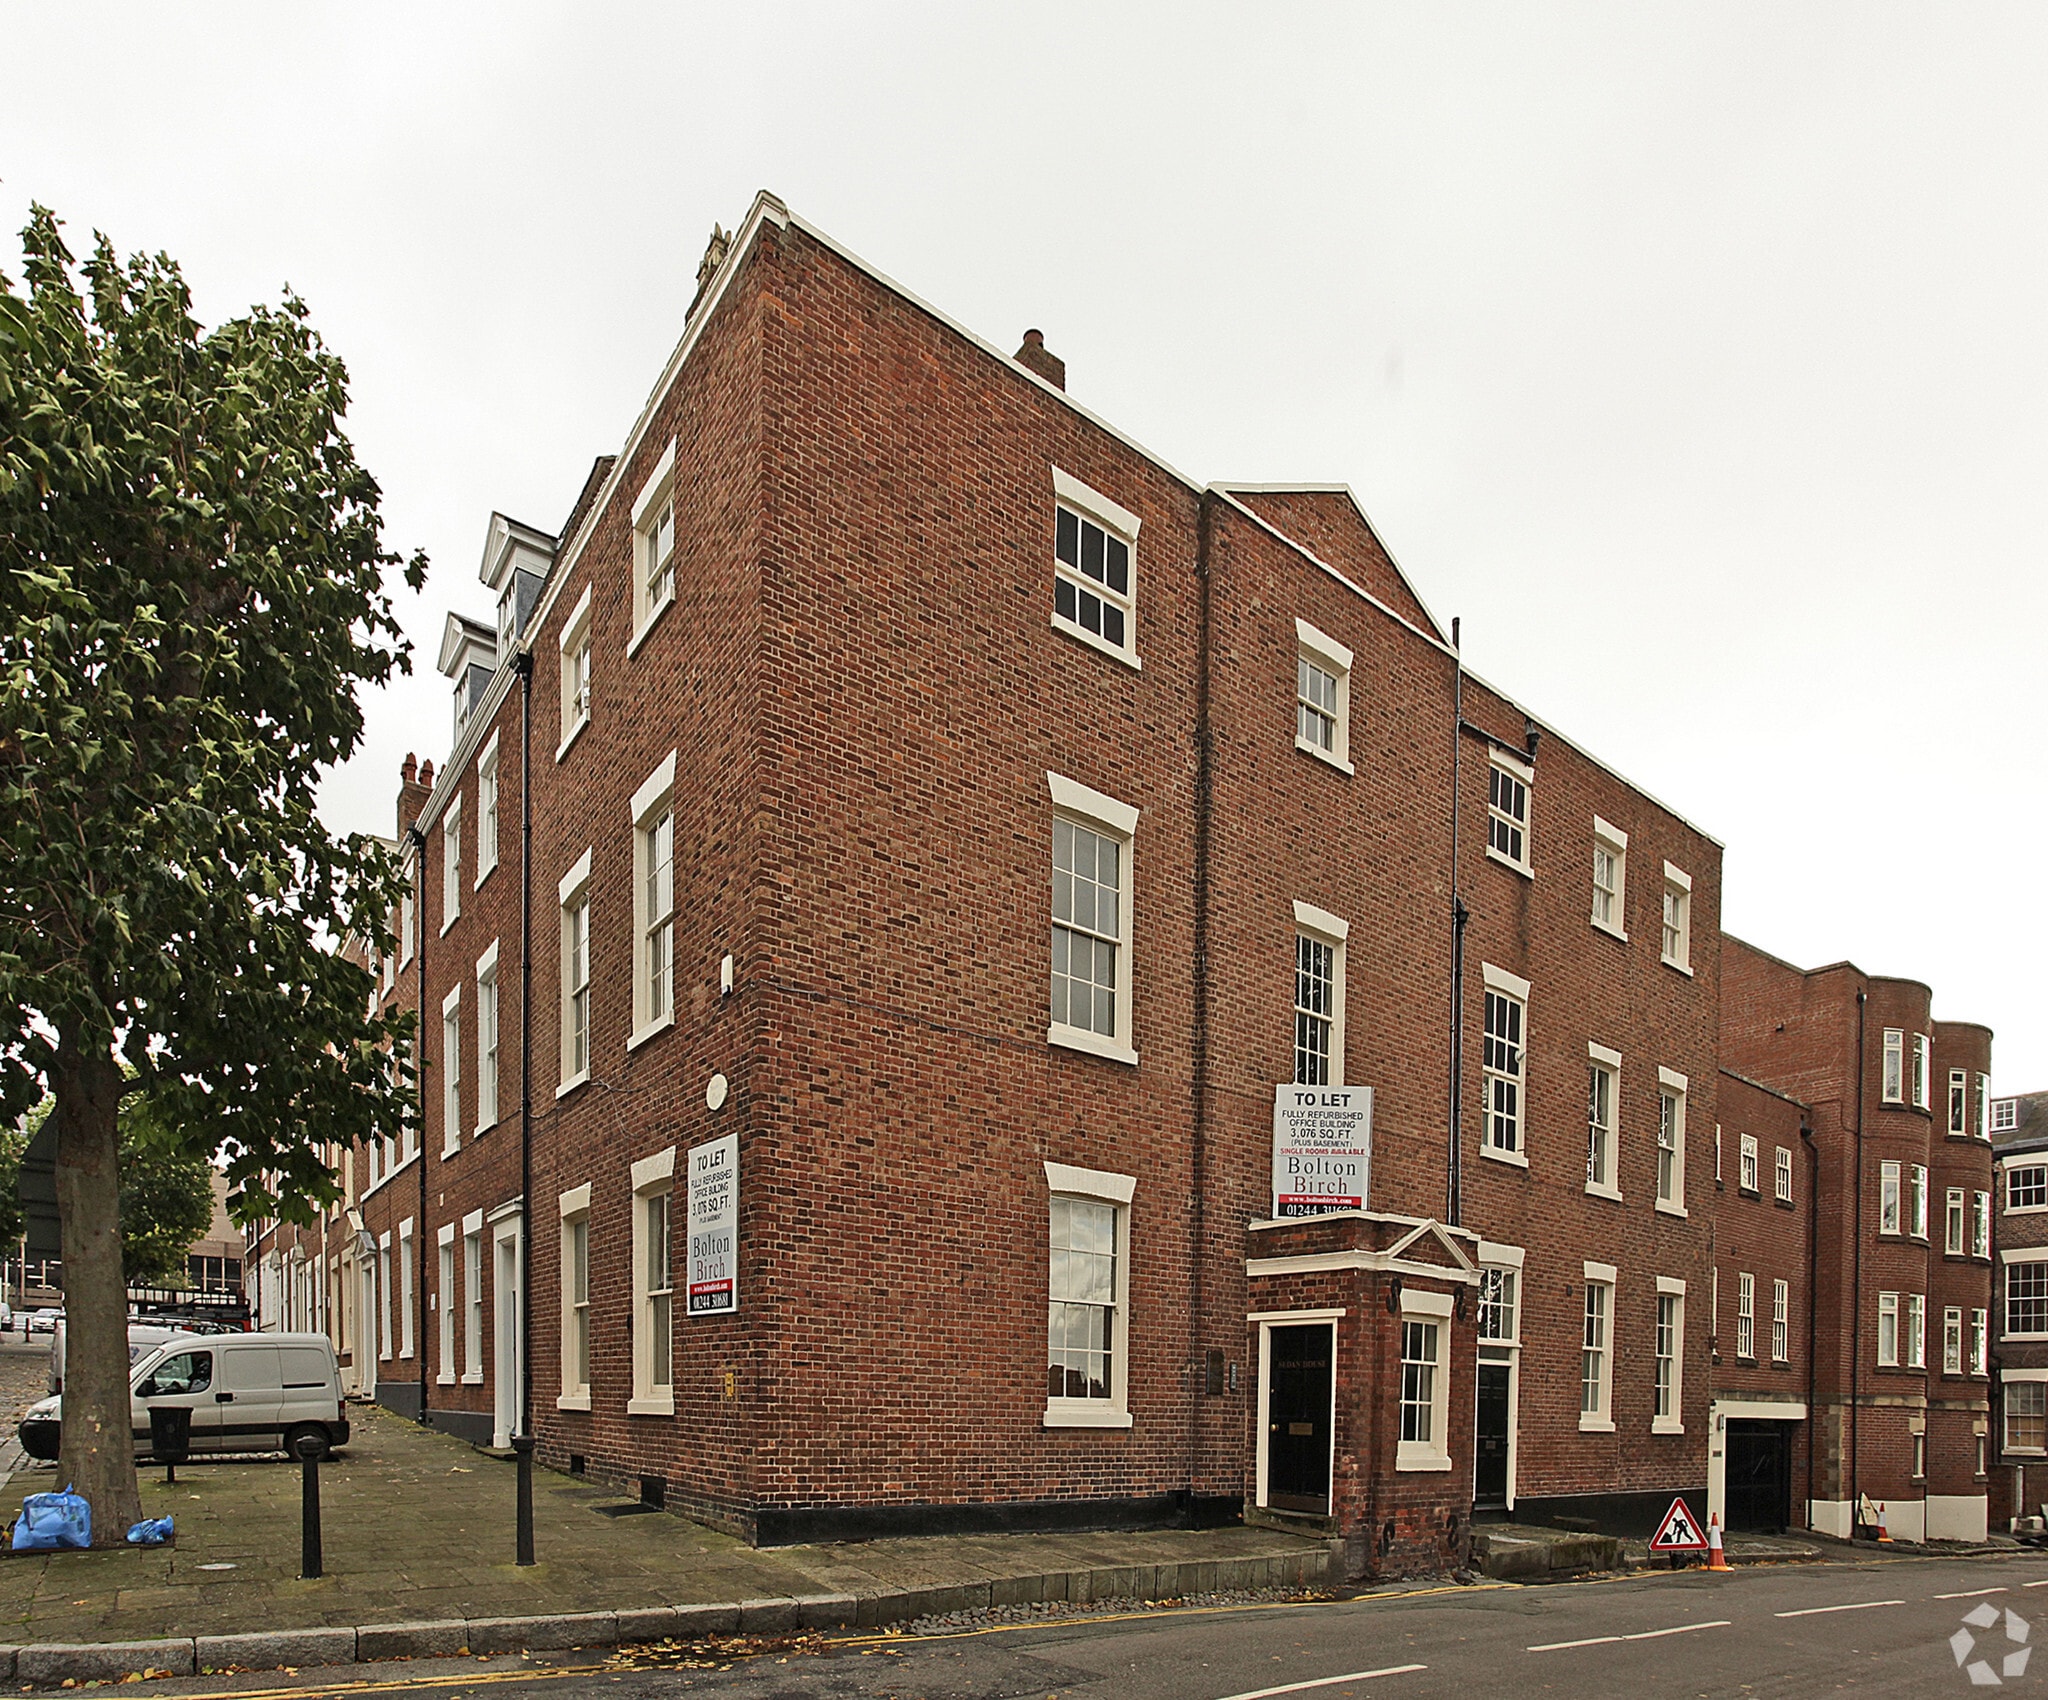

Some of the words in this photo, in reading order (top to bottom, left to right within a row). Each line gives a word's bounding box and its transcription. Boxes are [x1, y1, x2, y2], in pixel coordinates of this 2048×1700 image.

[1294, 1092, 1316, 1106] TO
[1321, 1093, 1351, 1107] LET
[1281, 1109, 1306, 1118] FULLY
[1307, 1110, 1364, 1121] REFURBISHED
[1289, 1118, 1317, 1127] OFFICE
[1319, 1119, 1356, 1129] BUILDING
[1291, 1139, 1312, 1147] (PLUS
[1313, 1140, 1353, 1148] BASEMENT)
[1280, 1147, 1304, 1155] SINGLE
[1330, 1148, 1365, 1156] AVAILABLE
[697, 1154, 708, 1171] TO
[709, 1148, 726, 1168] LET
[1288, 1156, 1356, 1176] Bolton
[1294, 1175, 1348, 1195] Birch
[1286, 1203, 1318, 1216] 01244
[693, 1233, 730, 1258] Bolton
[696, 1255, 725, 1281] Birch
